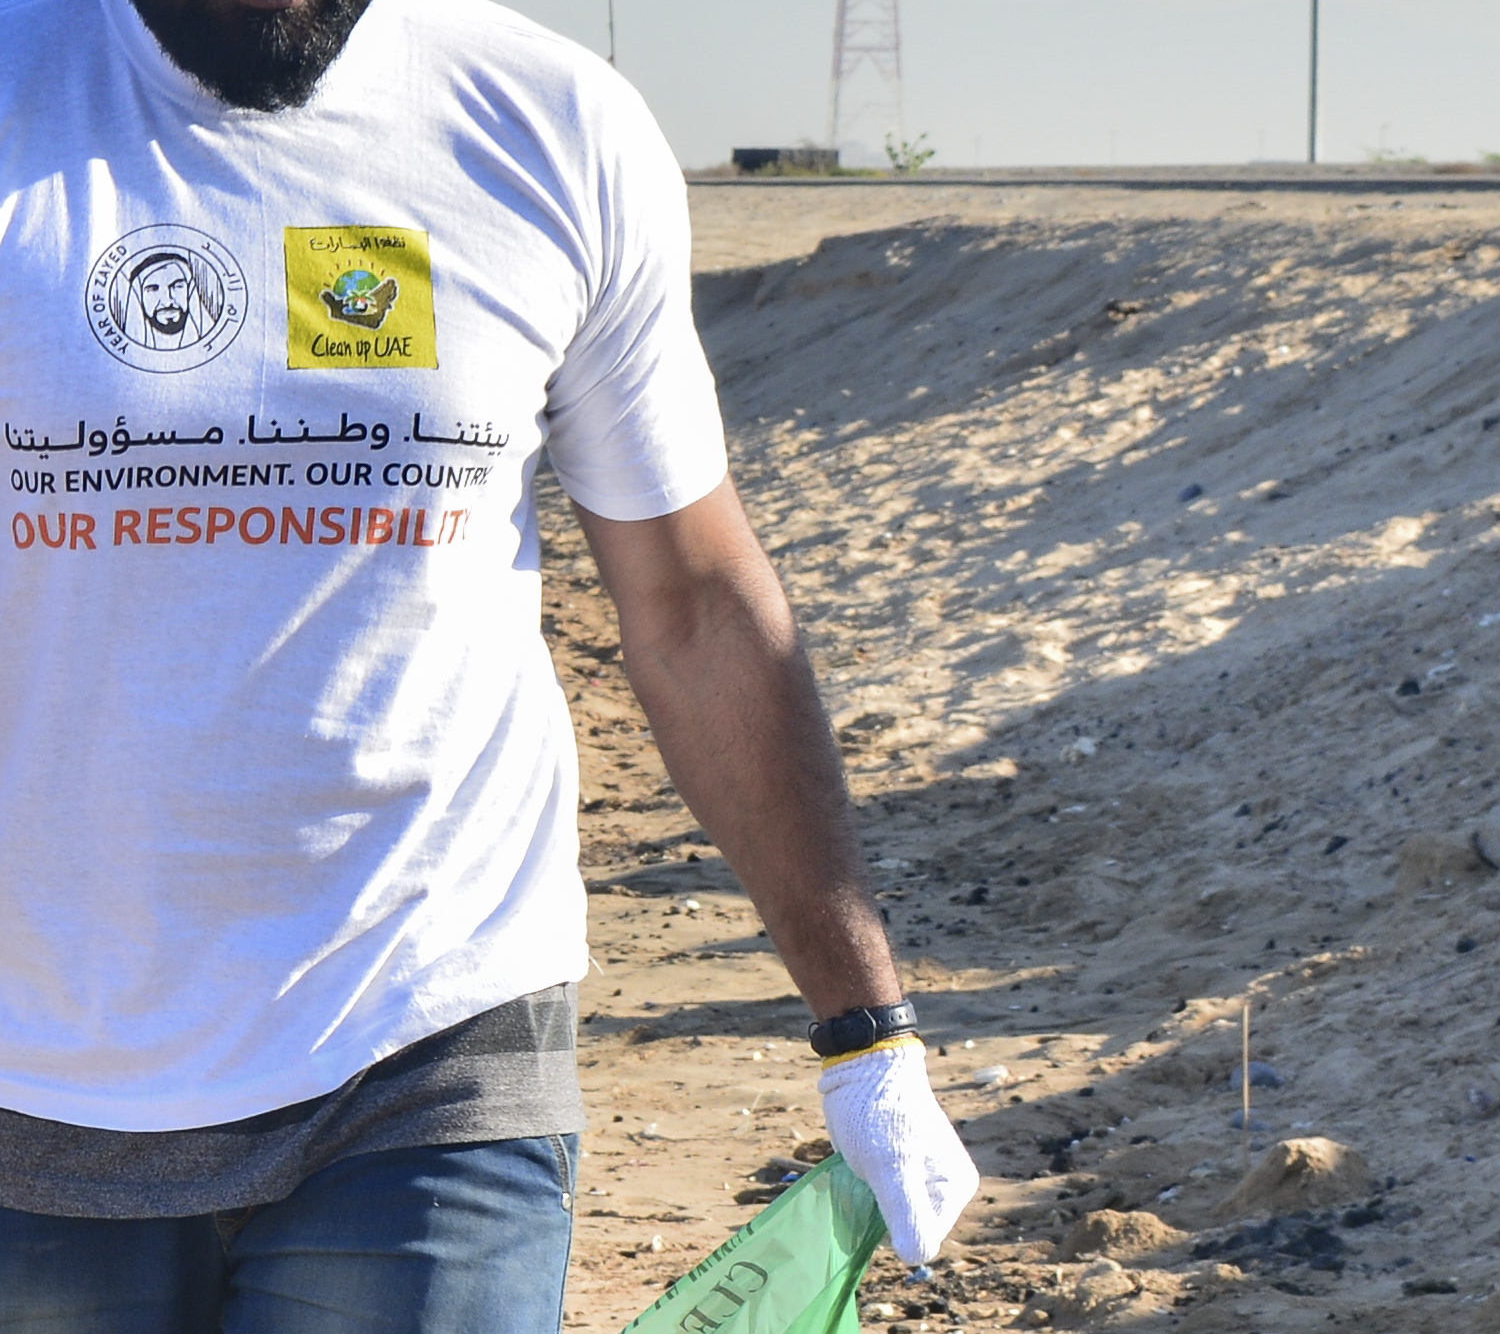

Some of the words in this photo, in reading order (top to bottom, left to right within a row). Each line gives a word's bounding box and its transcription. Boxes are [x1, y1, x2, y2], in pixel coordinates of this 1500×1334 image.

[93, 244, 128, 288] ZAYED
[92, 293, 107, 314] OF
[96, 316, 130, 355] YEAR
[311, 333, 352, 357] Clean
[356, 339, 371, 362] up
[374, 336, 413, 357] UAE
[4, 415, 225, 460] مسؤوليتنا
[10, 468, 56, 495] OUR
[65, 463, 295, 493] ENVIRONMENT.
[305, 462, 372, 487] OUR
[382, 463, 495, 489] COUNTRY.
[11, 511, 97, 551] OUR
